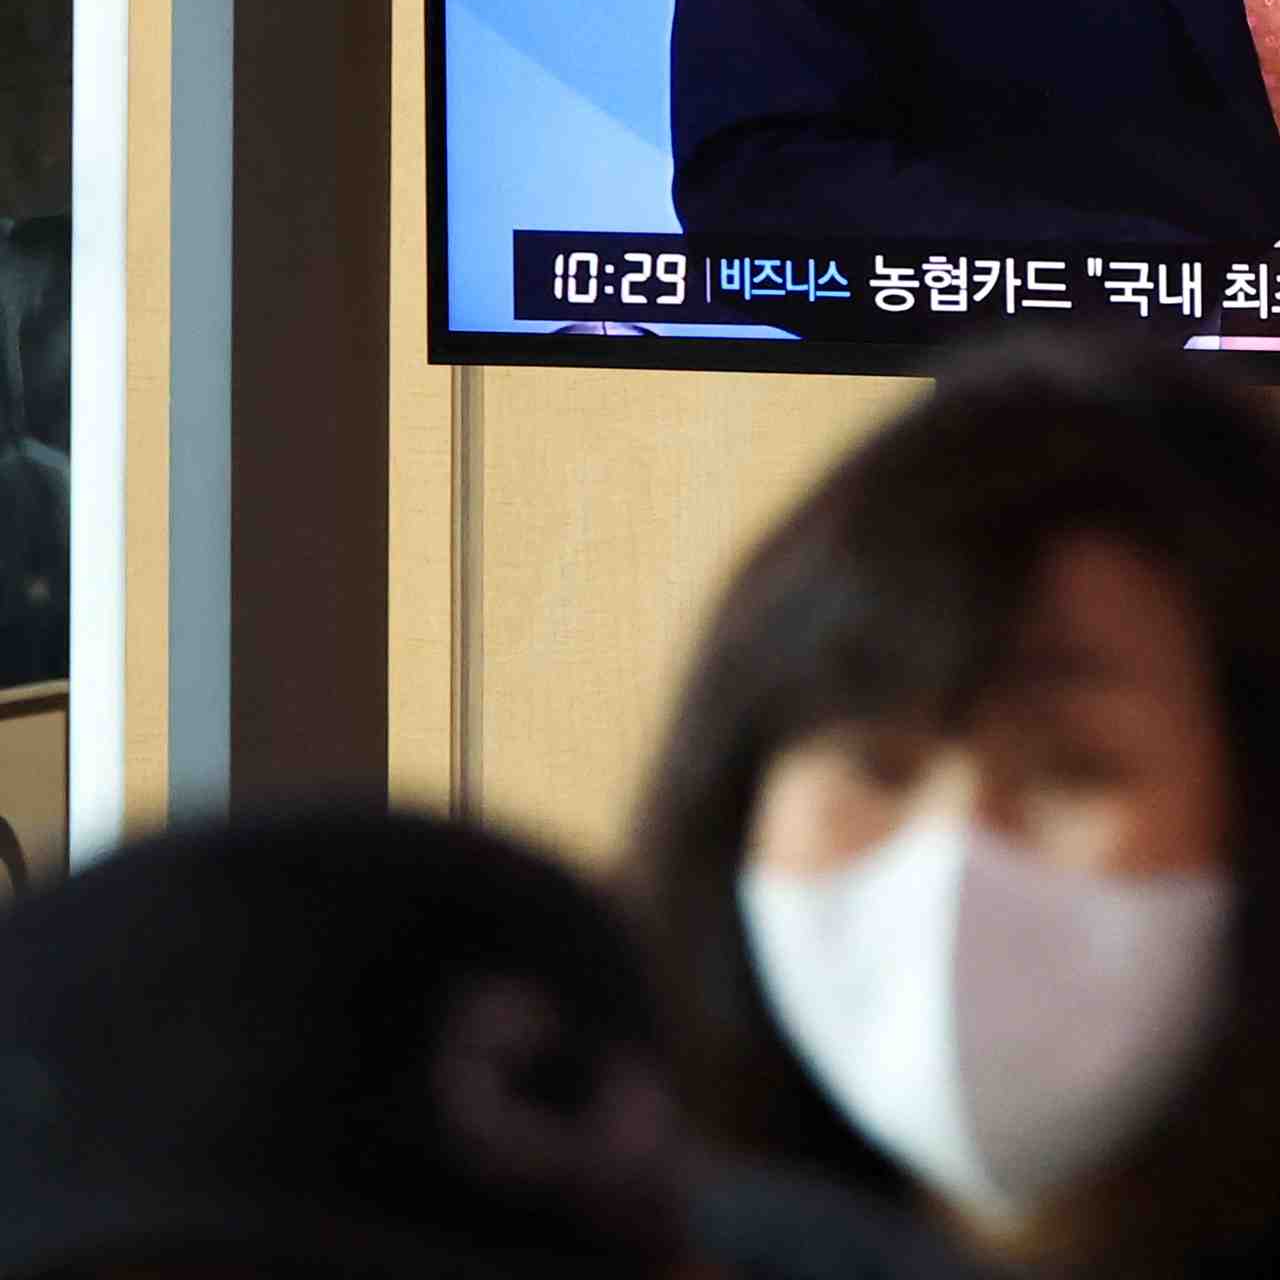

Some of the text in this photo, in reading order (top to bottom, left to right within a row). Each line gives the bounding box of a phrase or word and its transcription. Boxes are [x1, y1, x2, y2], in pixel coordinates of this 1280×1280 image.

[553, 252, 687, 305] 10:29
[720, 257, 851, 302] 비즈니스
[869, 254, 1073, 314] 농협카드
[1087, 257, 1202, 318] "국내
